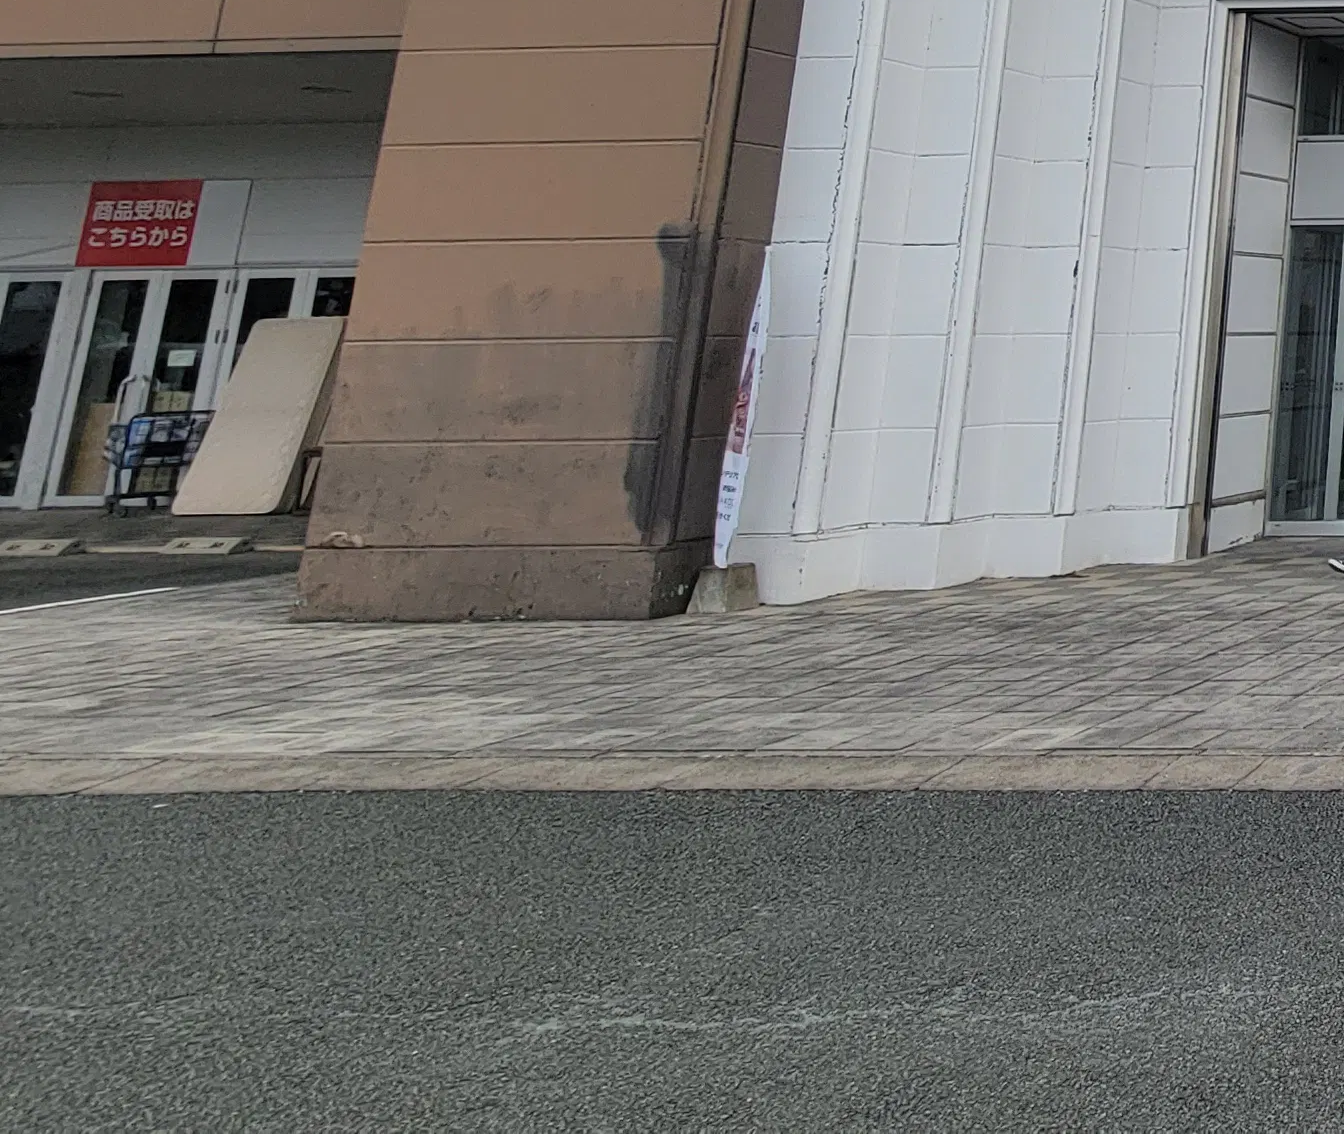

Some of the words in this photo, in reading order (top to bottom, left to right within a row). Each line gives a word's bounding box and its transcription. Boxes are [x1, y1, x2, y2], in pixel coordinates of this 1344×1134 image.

[92, 199, 196, 221] 商品受取は
[88, 226, 188, 247] こちらから
